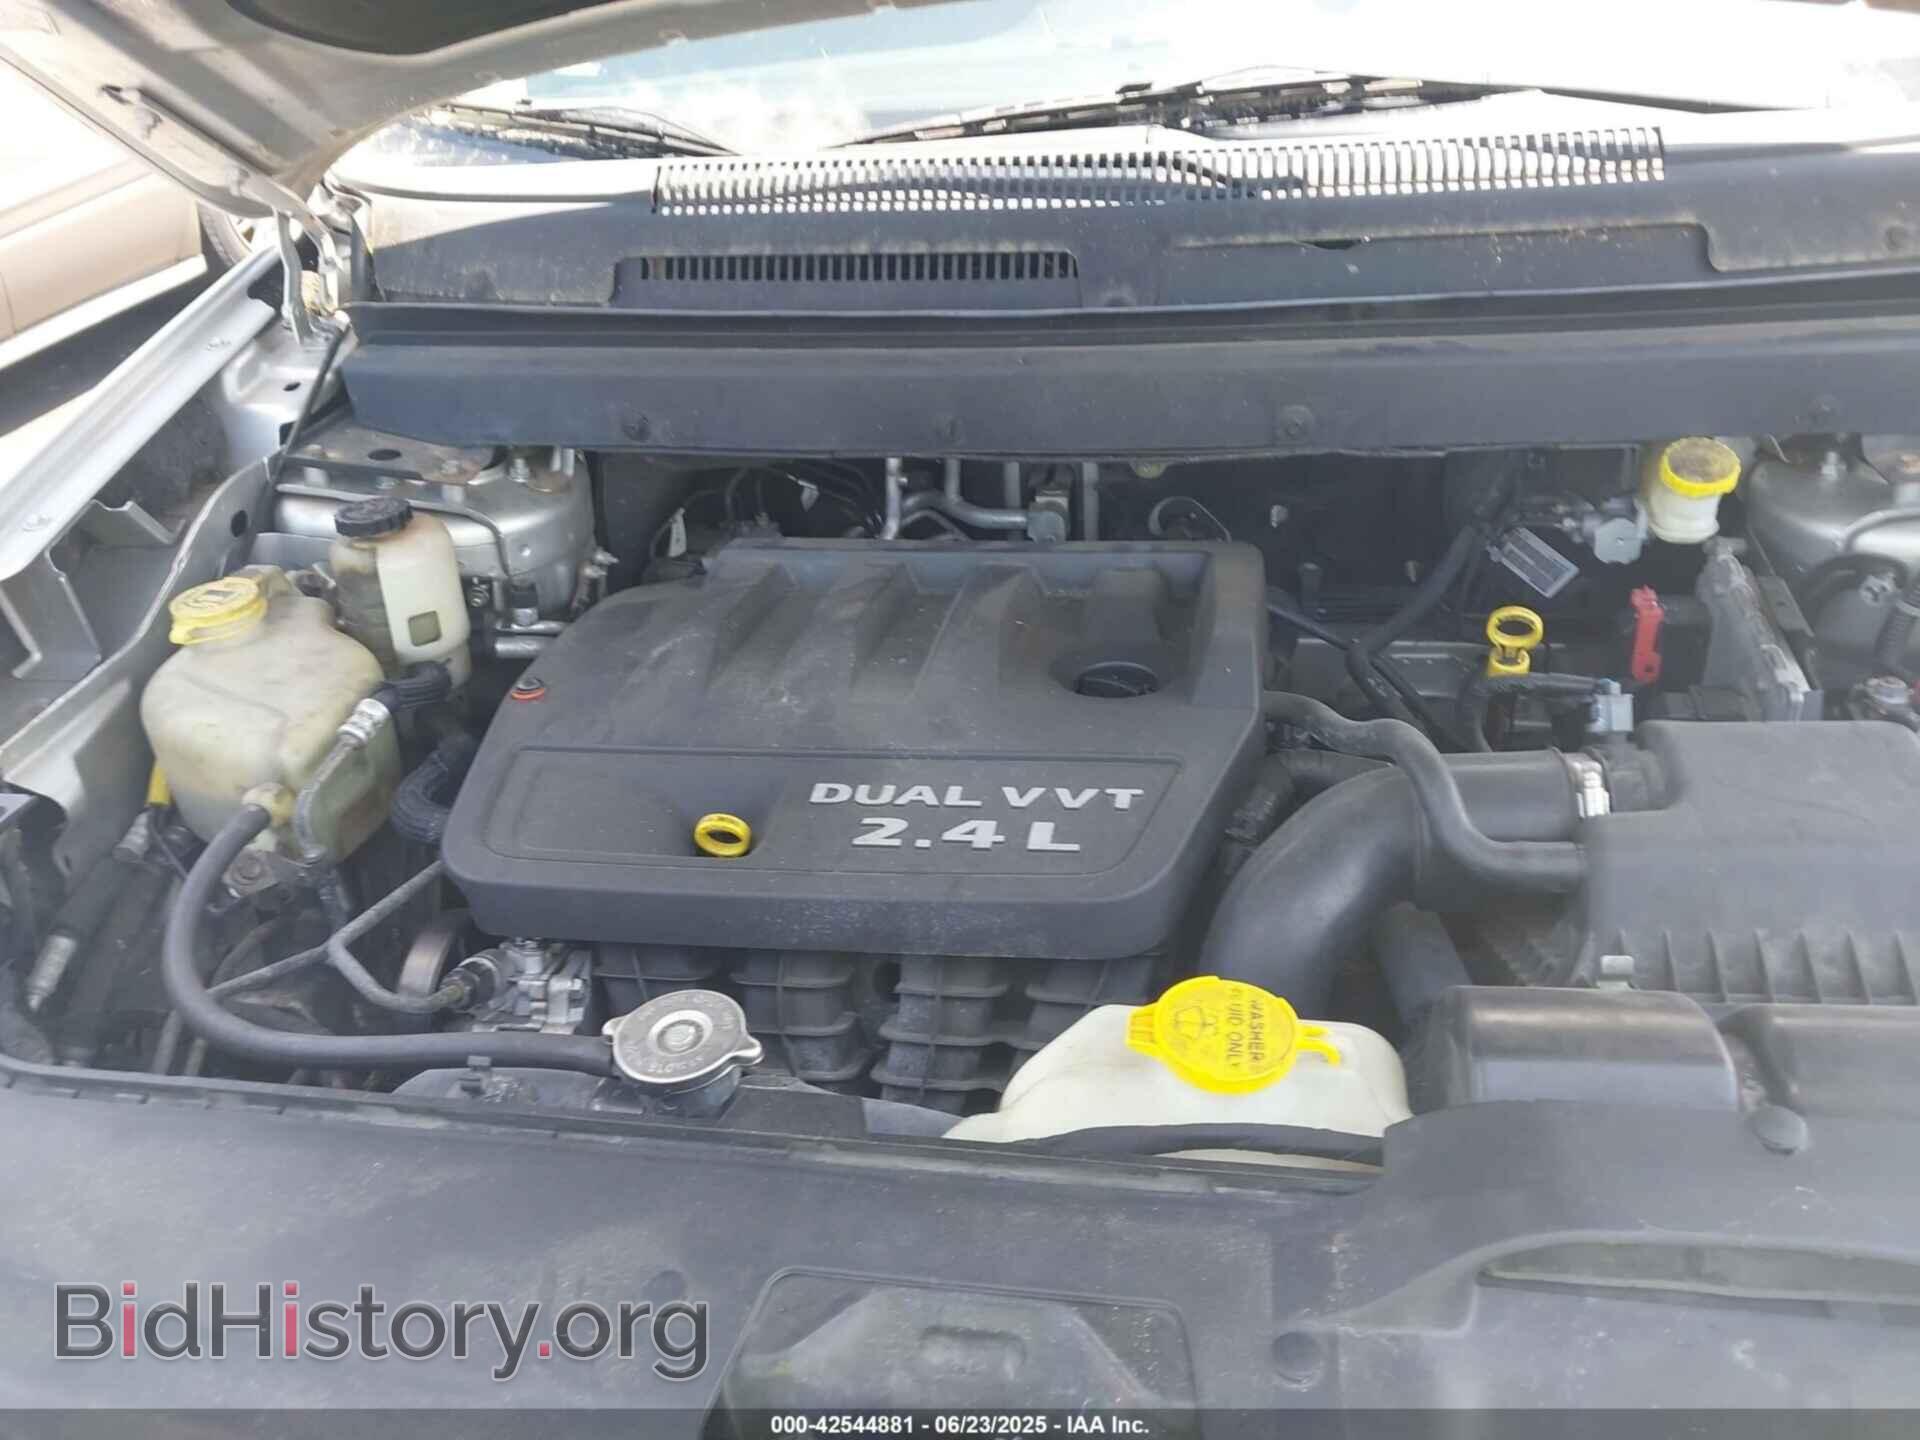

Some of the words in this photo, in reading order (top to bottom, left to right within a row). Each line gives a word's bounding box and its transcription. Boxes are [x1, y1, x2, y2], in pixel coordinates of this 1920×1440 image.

[808, 783, 984, 807] DUAL
[1001, 786, 1145, 809] VVT
[1227, 987, 1244, 1026] UID
[1248, 1000, 1265, 1064] WASHER
